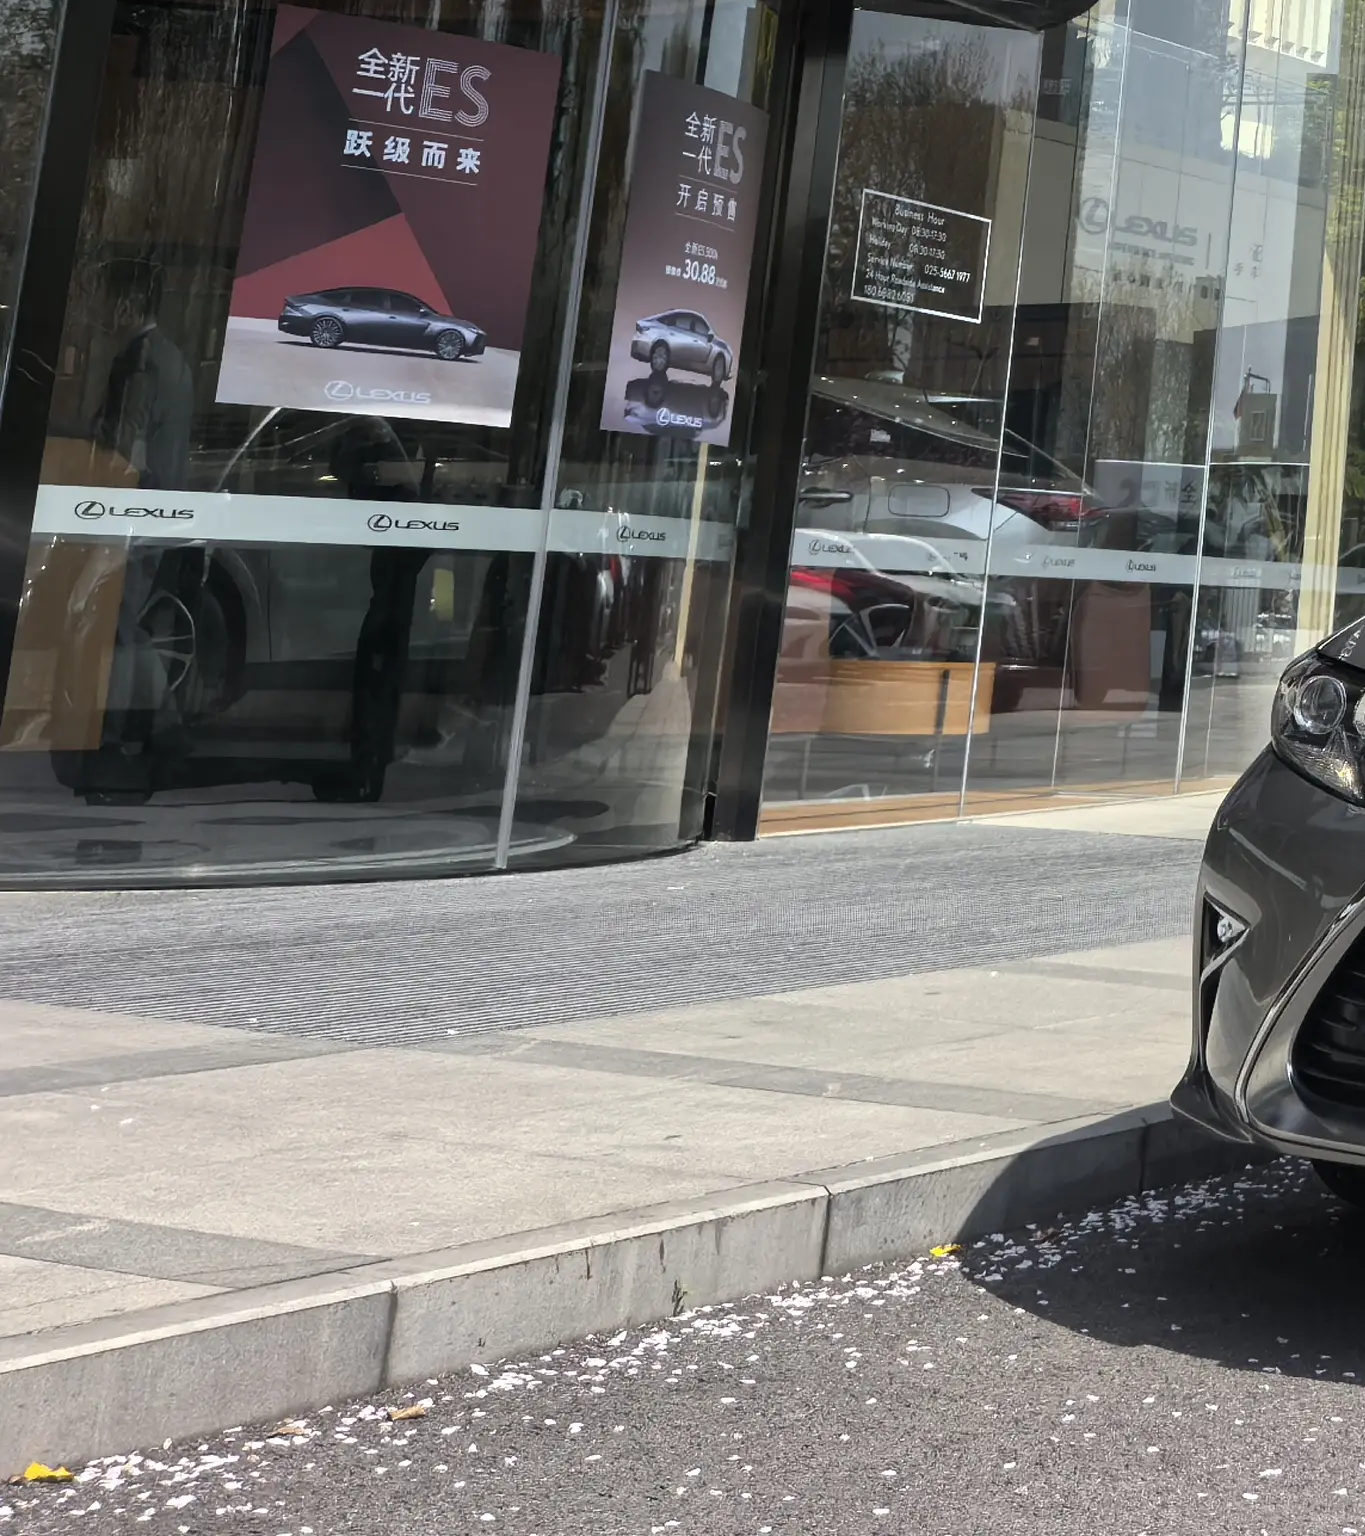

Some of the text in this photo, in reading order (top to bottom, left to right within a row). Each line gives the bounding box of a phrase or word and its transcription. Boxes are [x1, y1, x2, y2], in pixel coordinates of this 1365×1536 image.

[356, 48, 420, 85] 全新
[352, 83, 415, 114] 一代
[419, 58, 492, 128] ES
[685, 111, 717, 145] 全新
[343, 130, 481, 175] 跃级而来
[713, 120, 747, 185] ES
[683, 258, 716, 285] 30.88
[353, 387, 432, 405] LEXUS
[671, 413, 703, 428] LEXUS
[109, 506, 194, 520] LEXUS
[394, 519, 460, 531] LEXUS
[631, 529, 667, 541] LEXUS
